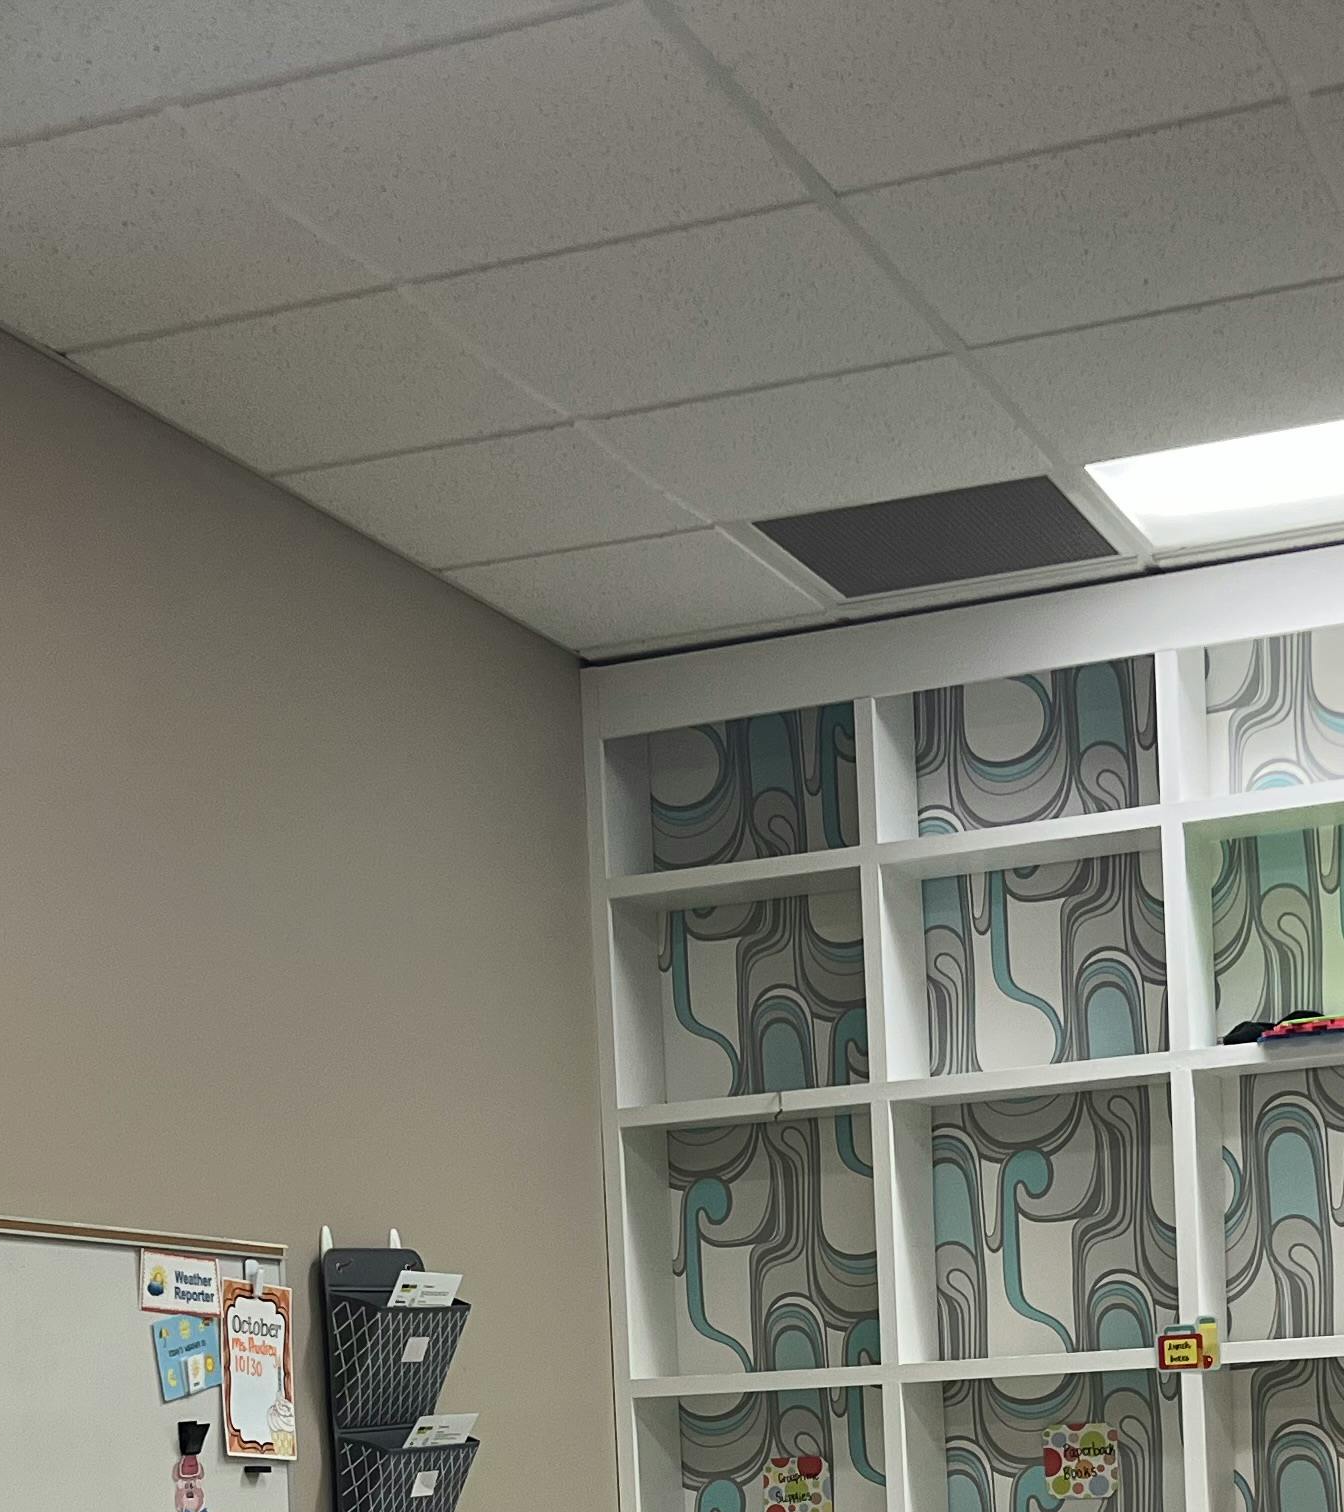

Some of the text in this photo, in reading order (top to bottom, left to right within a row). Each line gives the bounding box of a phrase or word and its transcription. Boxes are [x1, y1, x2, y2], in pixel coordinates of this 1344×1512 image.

[174, 1270, 213, 1287] Weather
[174, 1286, 215, 1304] Reporter
[232, 1314, 282, 1339] October
[1062, 1466, 1098, 1480] Books
